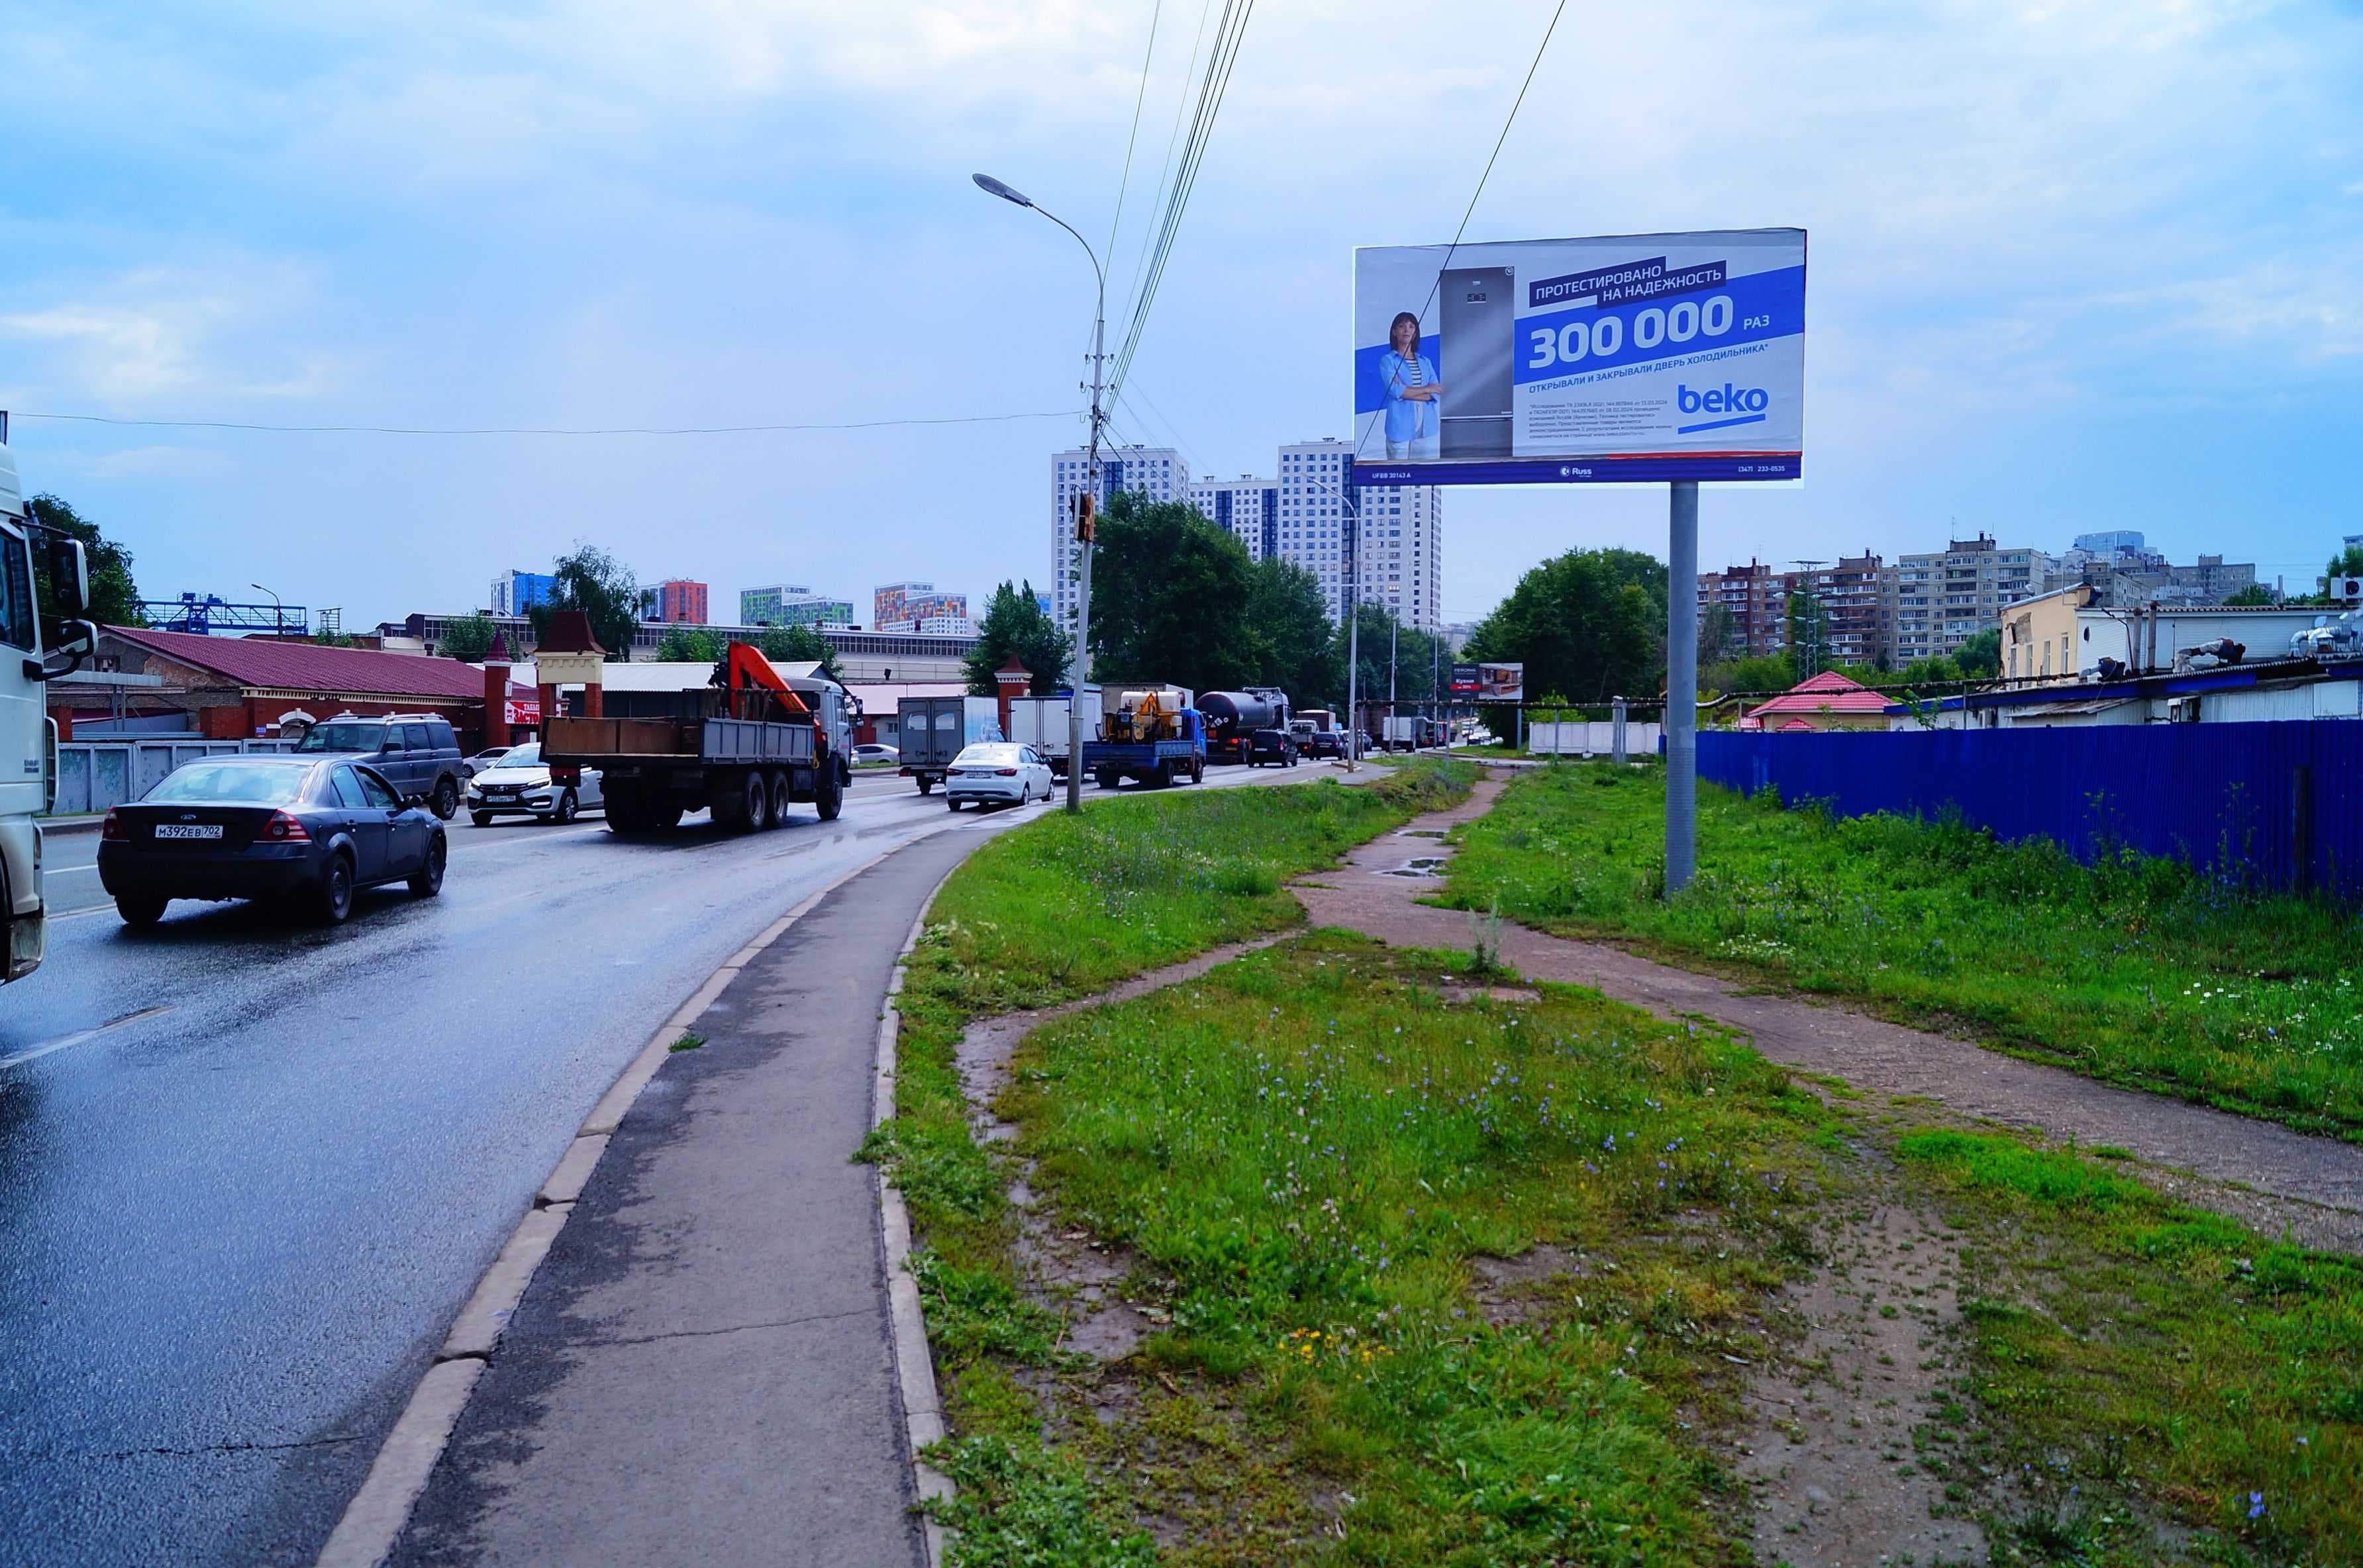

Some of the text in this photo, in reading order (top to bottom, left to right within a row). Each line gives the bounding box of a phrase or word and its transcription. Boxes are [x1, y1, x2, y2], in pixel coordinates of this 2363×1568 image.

[1536, 265, 1662, 300] ПРОТЕСТИРОВАНО
[1603, 270, 1722, 302] НА НАДЕЖНОСТЬ
[1529, 295, 1770, 369] 300 000 РАЗ
[1529, 377, 1586, 394] ОТКРЫВАЛИ
[1596, 364, 1652, 382] ЗАКРЫВАЛИ
[1654, 359, 1685, 372] ДВЕРЬ
[1678, 383, 1768, 414] beko
[203, 826, 220, 835] 702
